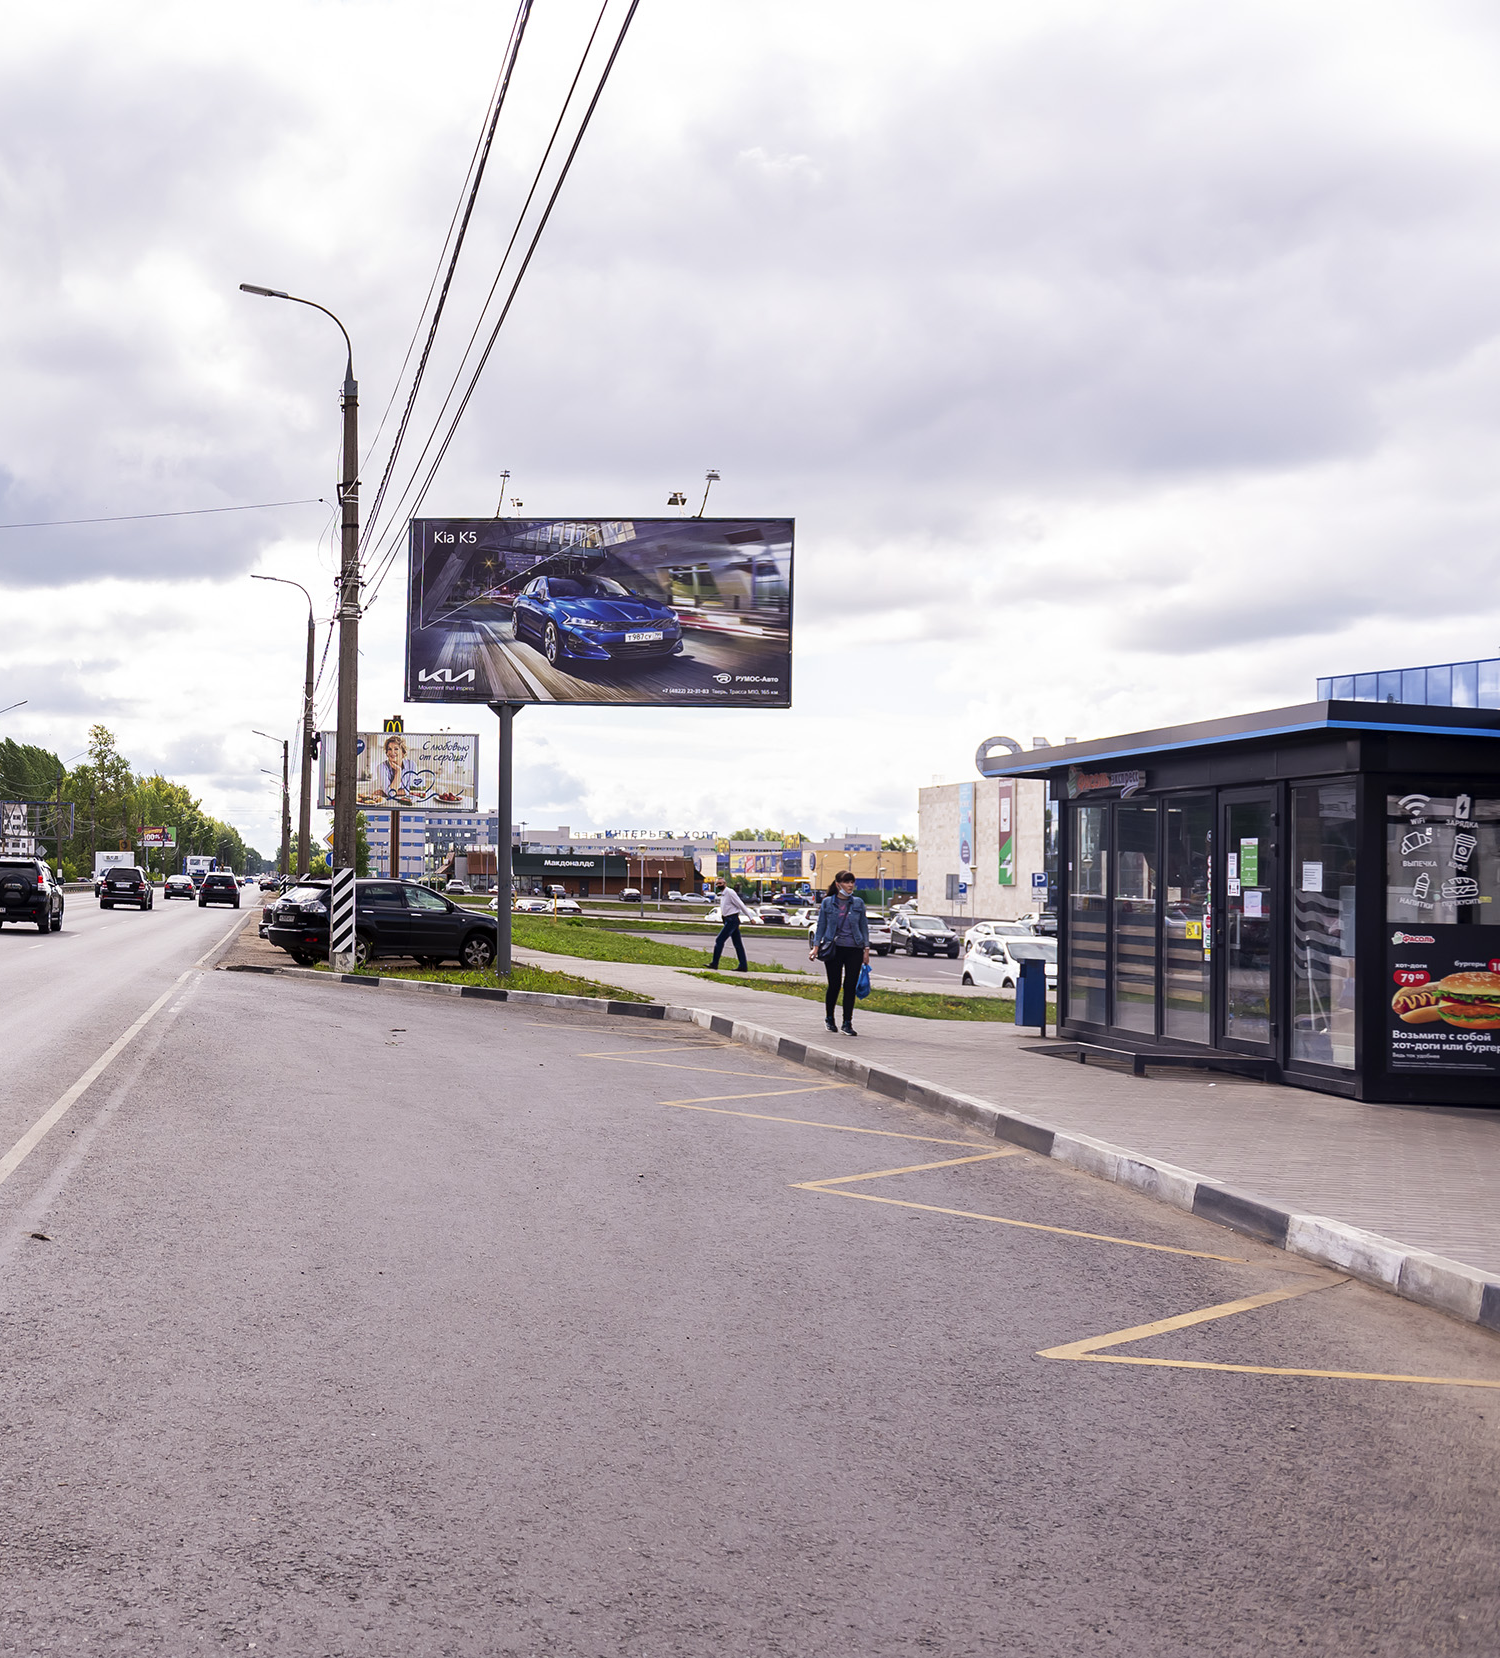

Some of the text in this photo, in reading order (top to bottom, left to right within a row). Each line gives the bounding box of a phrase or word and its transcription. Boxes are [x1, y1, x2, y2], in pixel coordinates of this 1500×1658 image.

[434, 531, 477, 544] Kia K5
[431, 741, 470, 752] любовью
[433, 752, 468, 765] сердца!
[1446, 819, 1479, 829] ЗАРЯДКА
[544, 859, 595, 867] Макдоналдс
[1448, 861, 1468, 872] КОФЕ
[1034, 874, 1045, 885] P
[1400, 897, 1434, 909] НАПИТКИ
[1454, 960, 1486, 968] бургеры
[1392, 1030, 1447, 1040] Возьмите
[1456, 1032, 1491, 1041] собой
[1392, 1042, 1440, 1051] хот-доги
